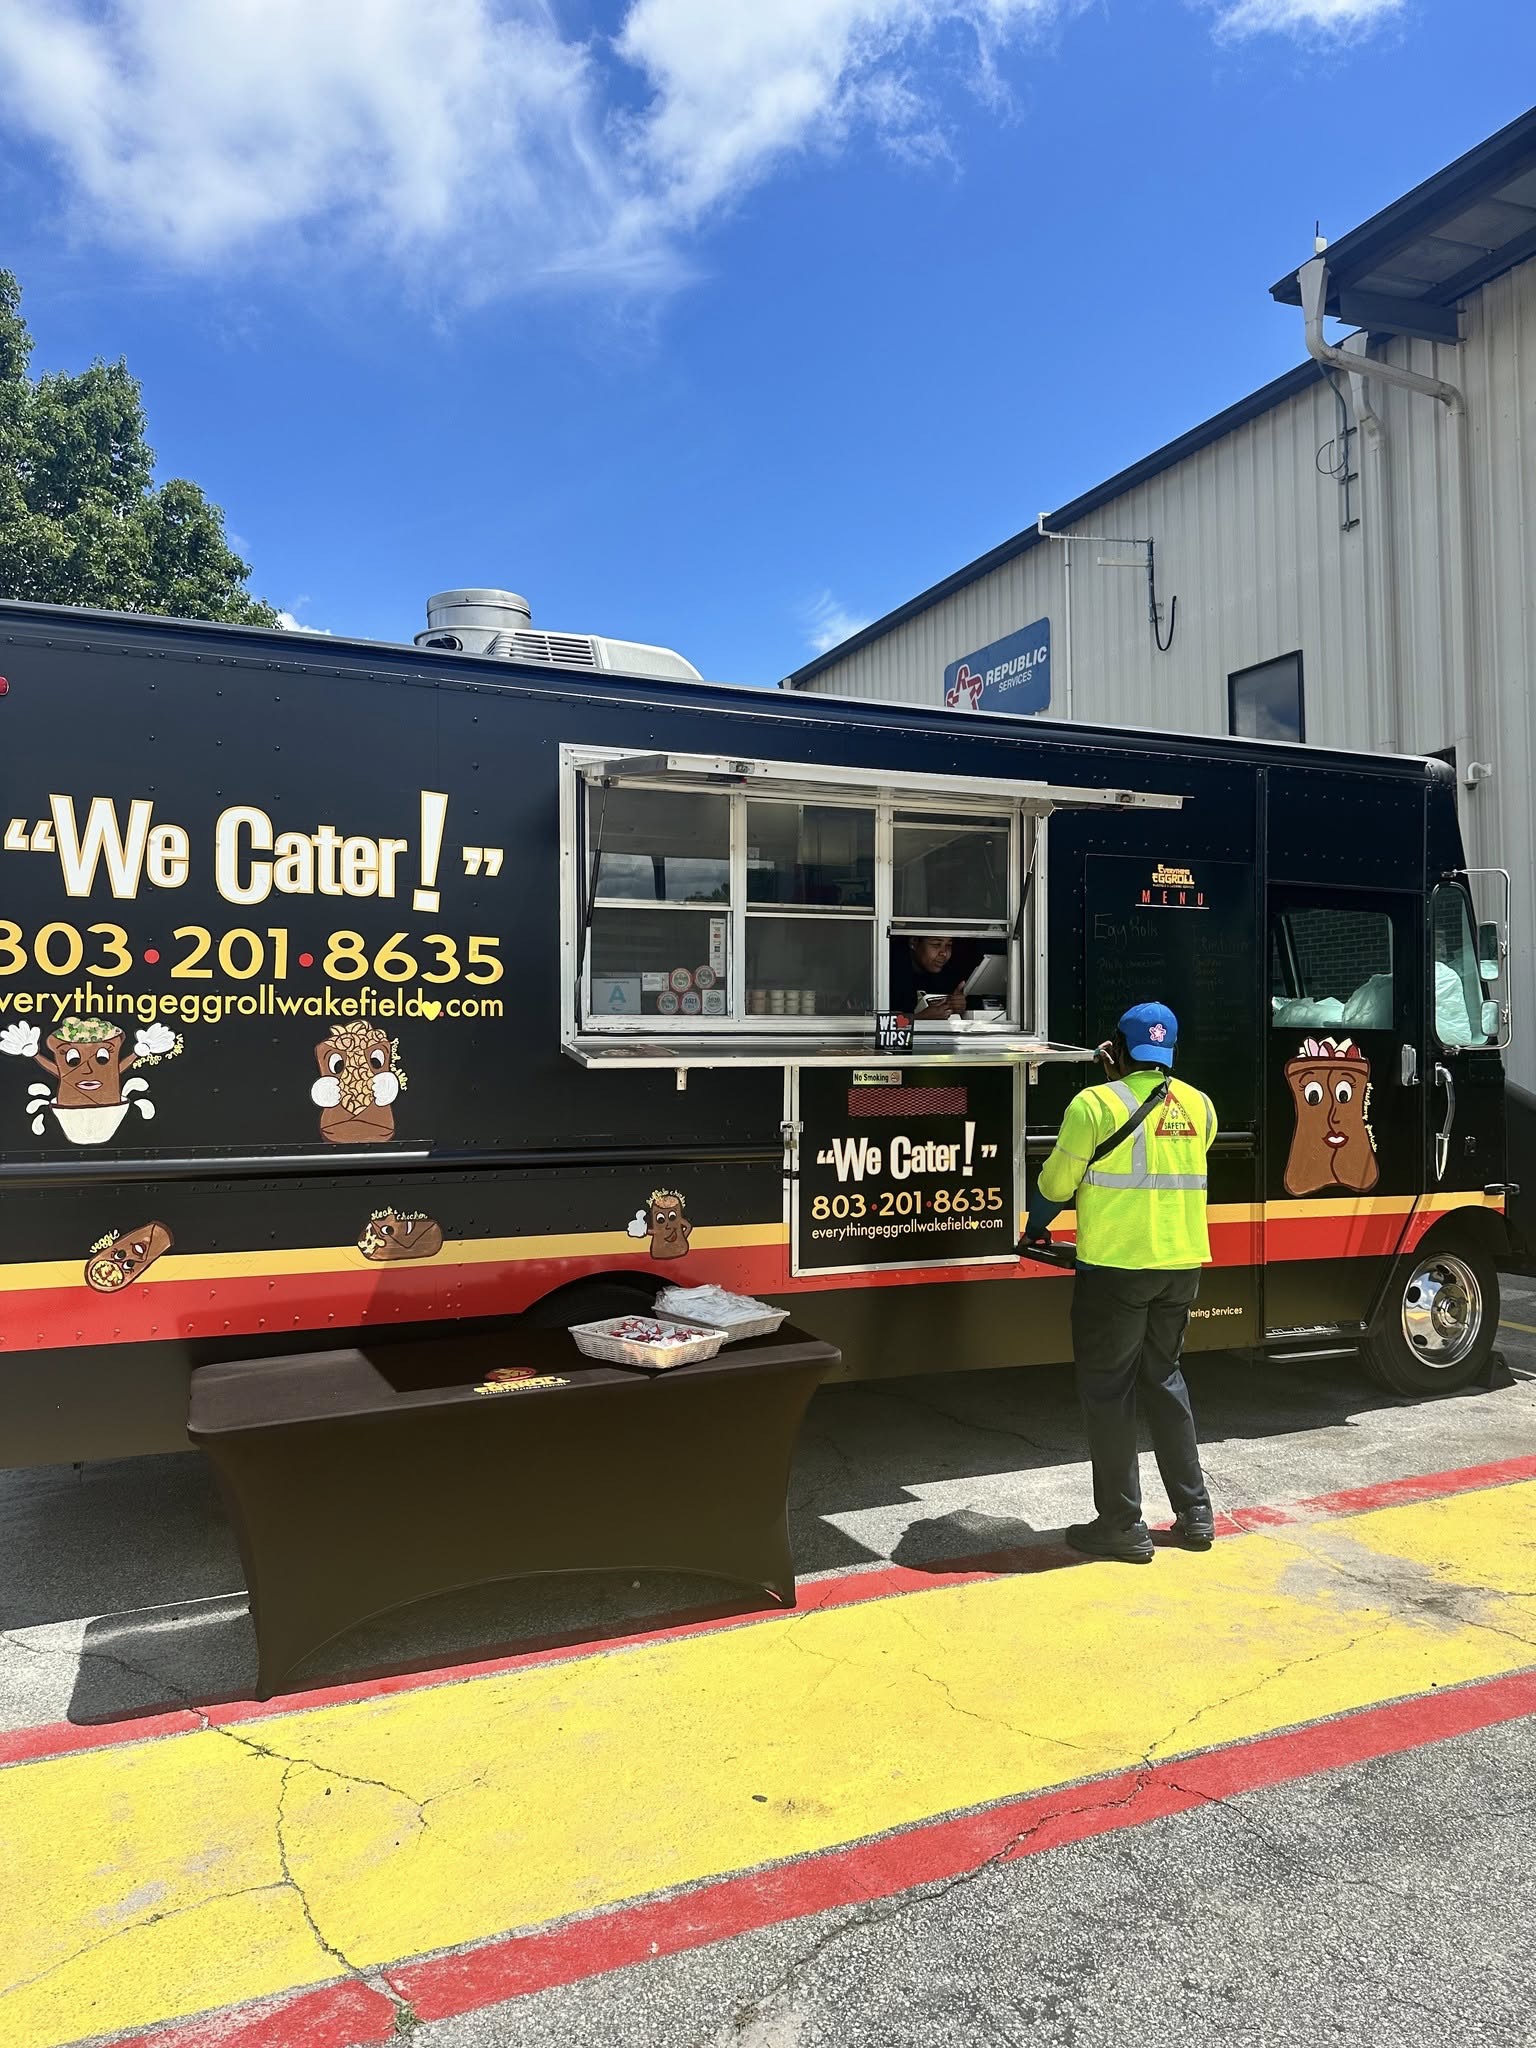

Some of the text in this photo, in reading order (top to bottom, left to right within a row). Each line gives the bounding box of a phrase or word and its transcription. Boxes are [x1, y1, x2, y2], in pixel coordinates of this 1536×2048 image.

[985, 645, 1048, 687] REPUBLIC
[998, 669, 1033, 693] SERVICES
[1152, 872, 1195, 885] EGGROLL
[1142, 889, 1204, 906] MENU
[607, 984, 627, 1004] A
[0, 981, 504, 1024] verythingeggrollwakefield.com
[879, 1015, 897, 1031] WE
[879, 1031, 911, 1046] TIPS!
[854, 1073, 889, 1083] No Smoking
[1164, 1121, 1186, 1130] SAFETY
[90, 1229, 120, 1253] veggie
[1211, 1306, 1243, 1316] Services
